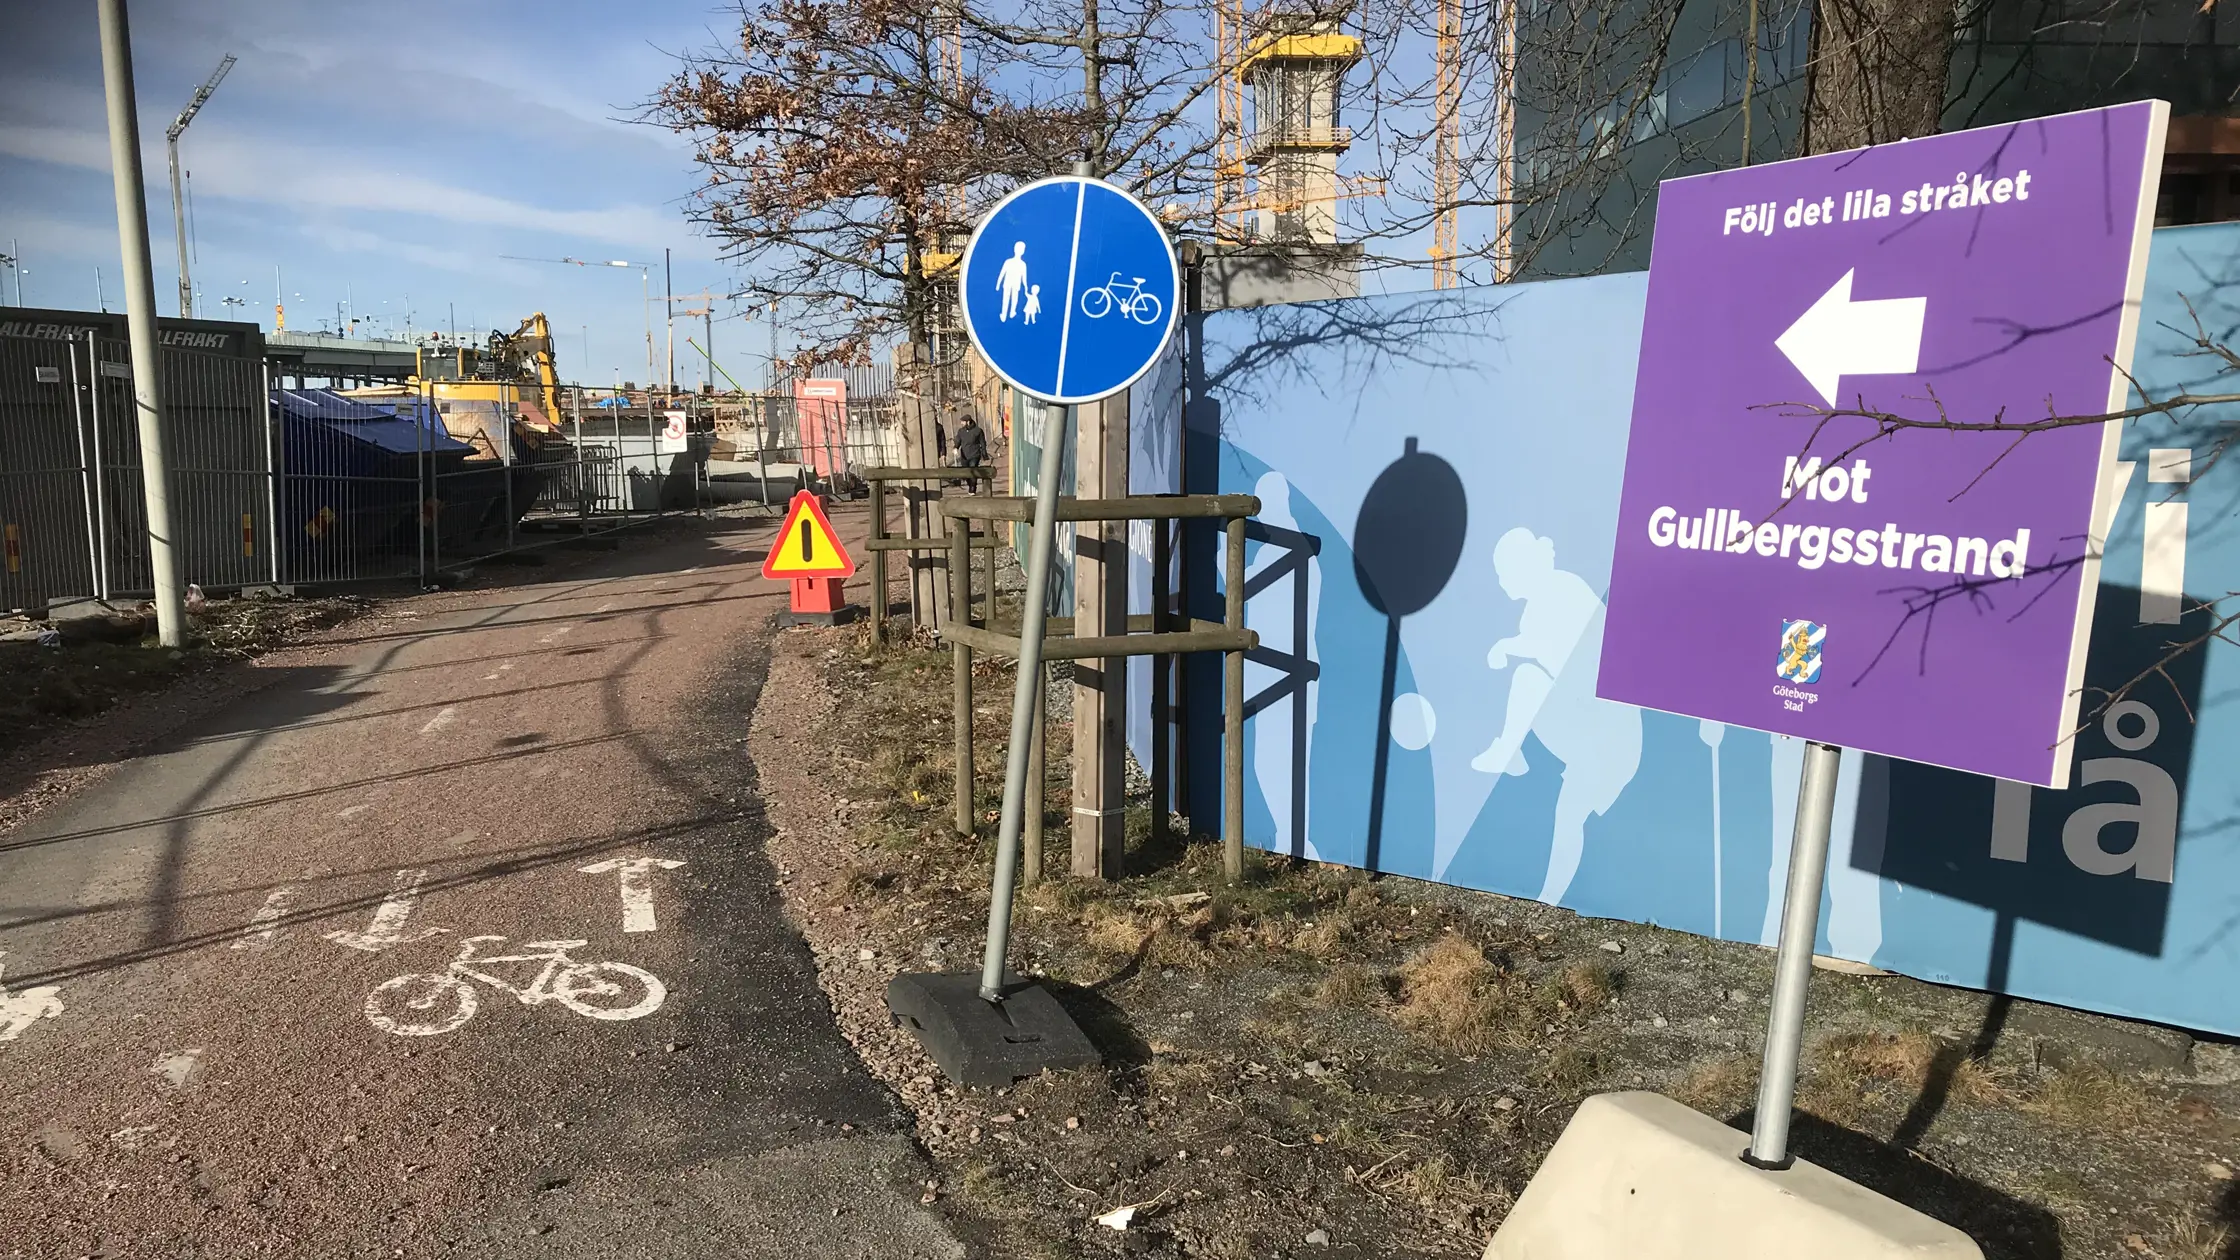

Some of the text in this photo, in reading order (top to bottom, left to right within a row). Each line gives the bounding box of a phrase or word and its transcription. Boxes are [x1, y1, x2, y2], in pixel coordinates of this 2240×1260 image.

[1723, 170, 2031, 236] Följ det lila stråket
[157, 330, 229, 348] LLFRAKT
[1781, 455, 1871, 503] Mot
[1647, 505, 2031, 579] Gullbergsstrand
[1772, 685, 1819, 704] Göteborgs
[1783, 699, 1804, 712] Stad
